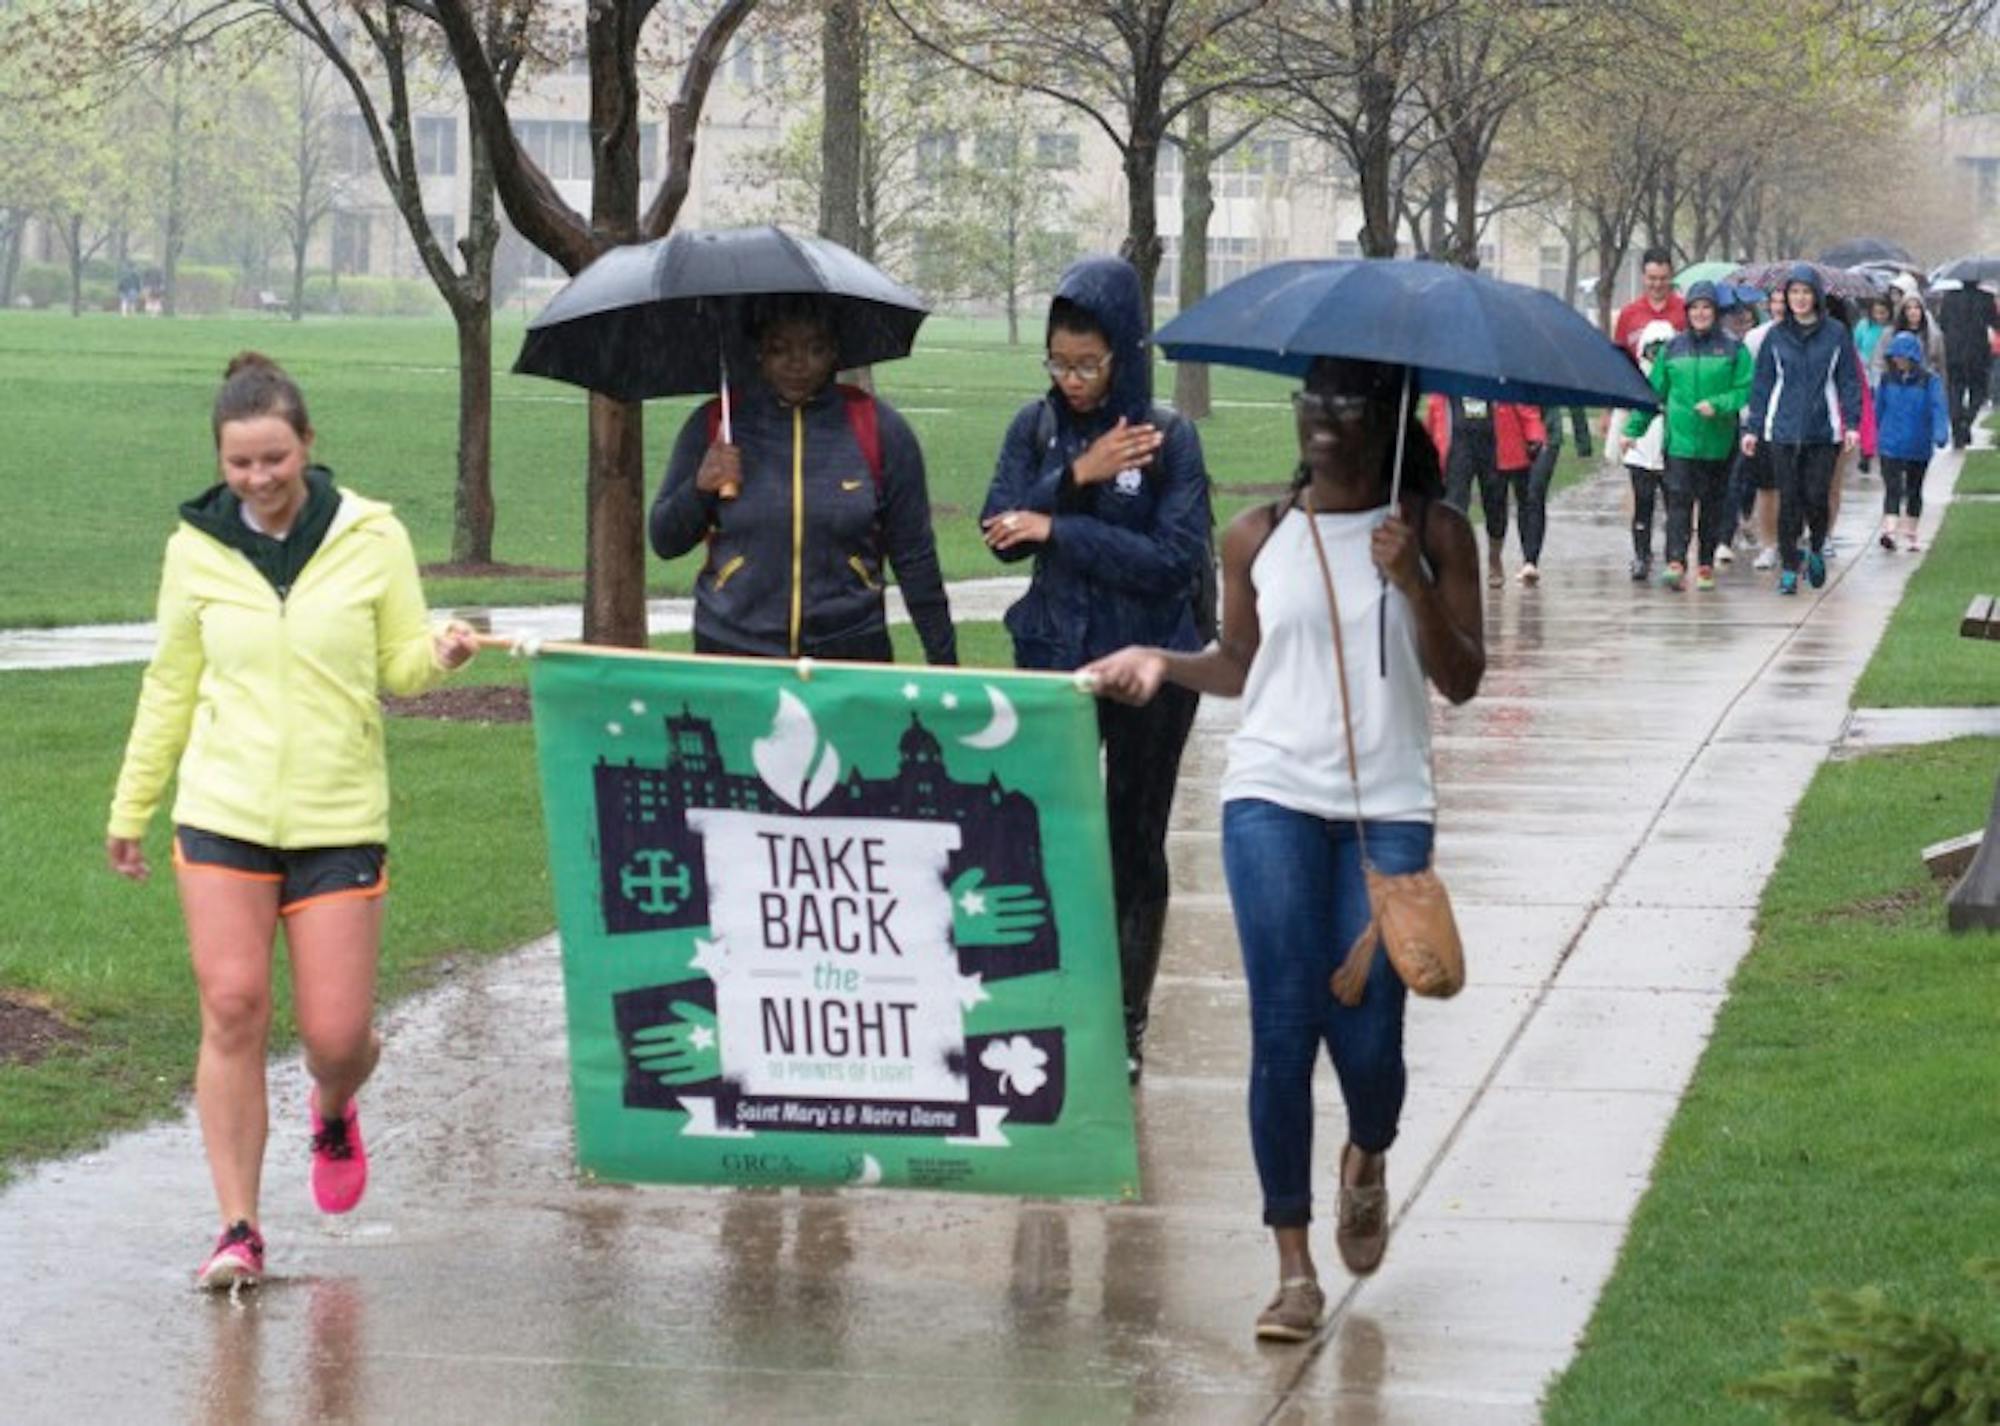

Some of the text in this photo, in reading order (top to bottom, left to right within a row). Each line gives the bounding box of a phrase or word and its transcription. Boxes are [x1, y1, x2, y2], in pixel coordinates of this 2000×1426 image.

[757, 832, 889, 894] TAKE
[760, 892, 902, 956] BACK
[813, 961, 860, 991] the
[760, 996, 917, 1058] NIGHT
[788, 1062, 844, 1081] POINTS
[848, 1063, 867, 1081] OF
[872, 1064, 915, 1083] LIGHT
[736, 1102, 957, 1127] Saint Mary's & Notre Dame
